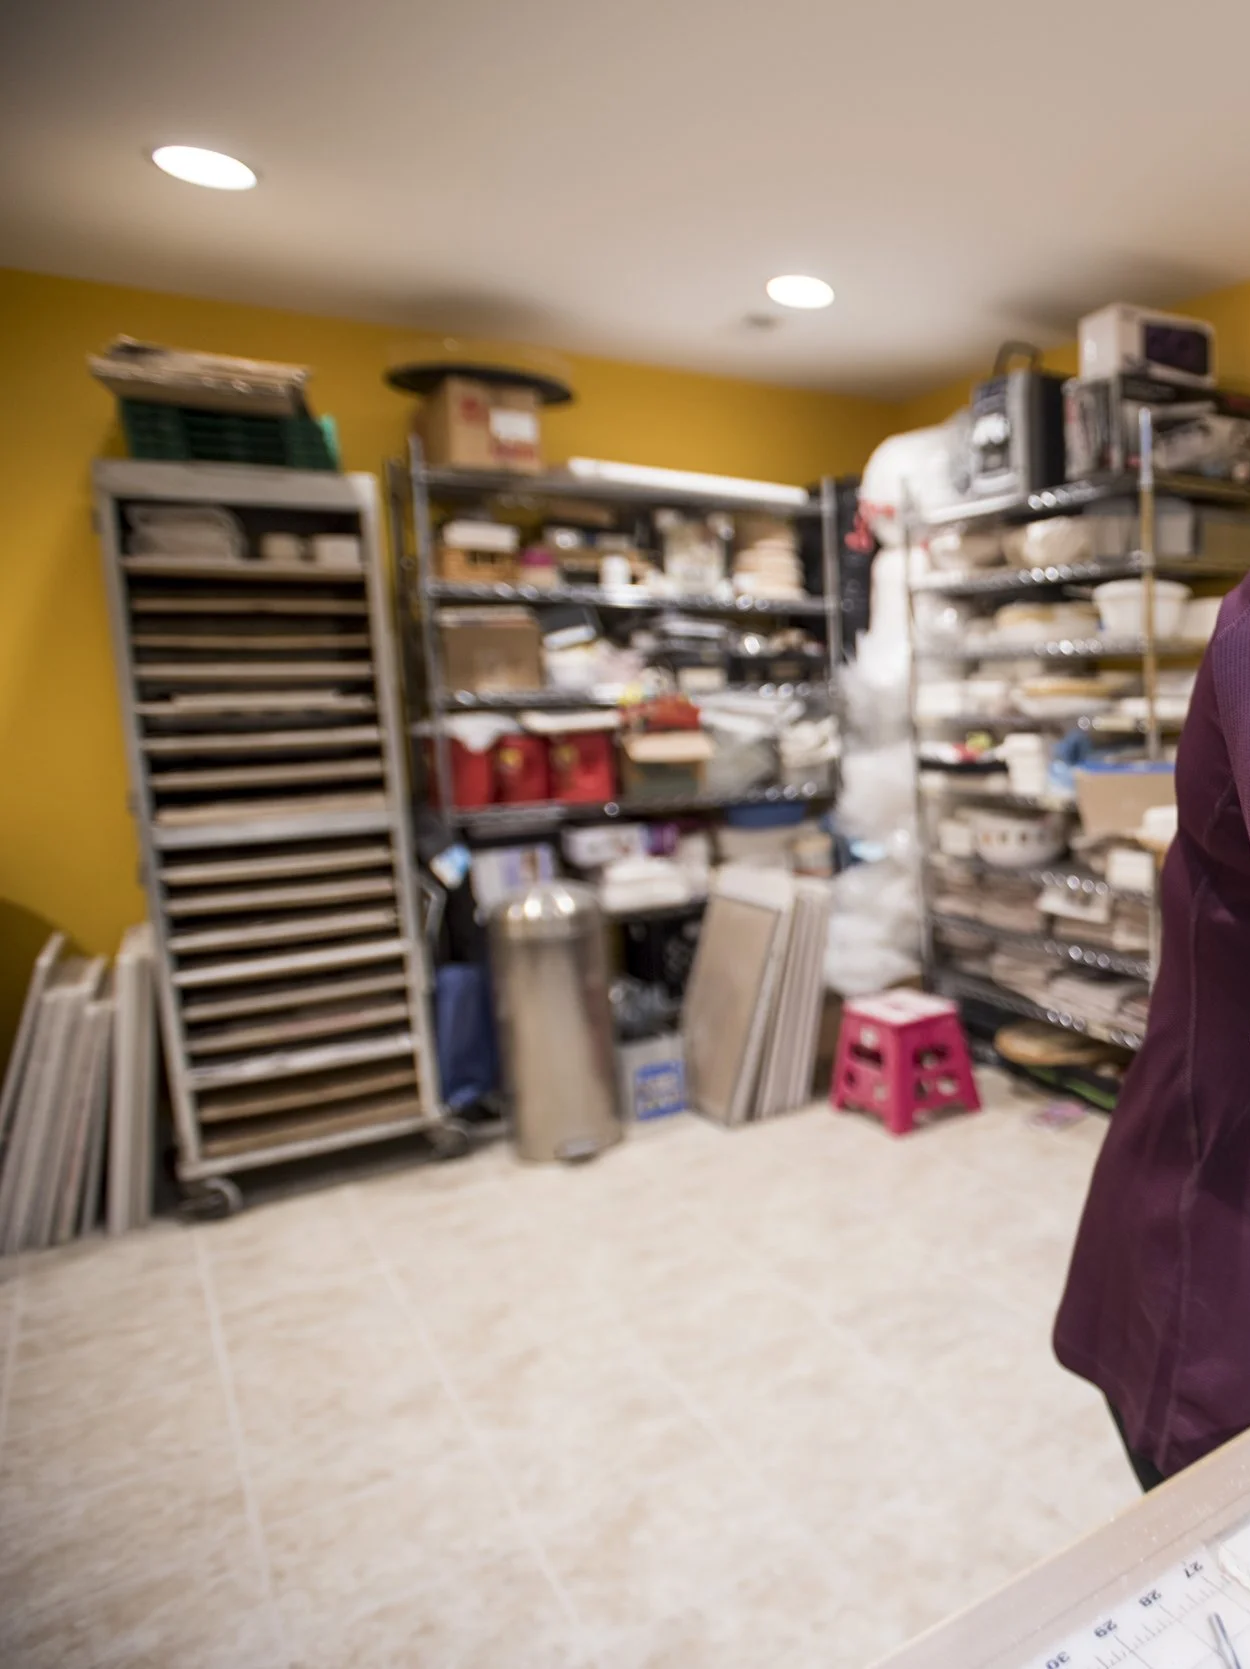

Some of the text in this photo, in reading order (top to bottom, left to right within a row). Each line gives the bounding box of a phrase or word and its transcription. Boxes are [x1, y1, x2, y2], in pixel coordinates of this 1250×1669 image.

[1184, 1560, 1203, 1578] 27
[1138, 1589, 1162, 1607] 28
[1094, 1619, 1118, 1638] 29
